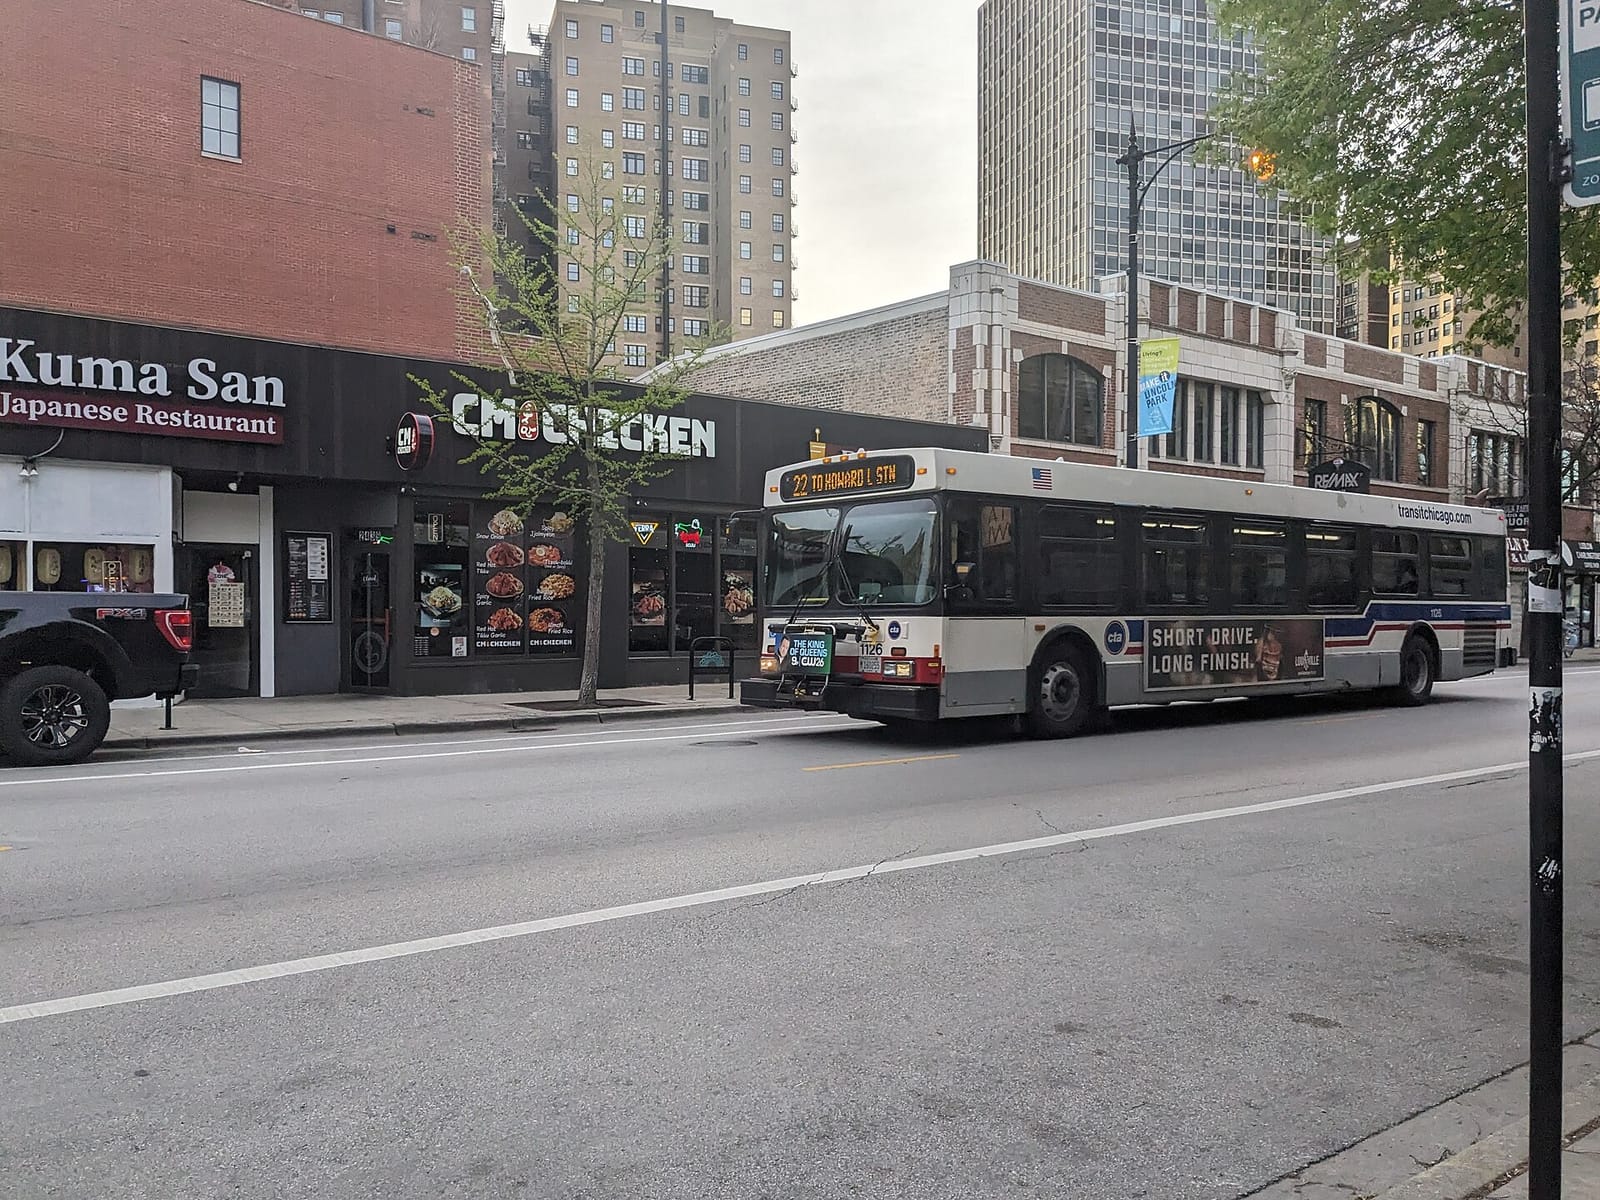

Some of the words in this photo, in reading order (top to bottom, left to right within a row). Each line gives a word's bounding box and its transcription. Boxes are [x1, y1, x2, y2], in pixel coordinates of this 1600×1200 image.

[0, 337, 172, 396] Kuma
[187, 358, 286, 407] San
[1160, 372, 1169, 382] it
[1146, 393, 1168, 408] PARK
[0, 392, 128, 421] Japanese
[135, 403, 277, 435] Restaurant
[452, 393, 516, 439] CM
[793, 473, 808, 496] 22
[812, 473, 823, 492] TO
[825, 469, 864, 490] HOWARD
[867, 467, 873, 486] L
[876, 464, 896, 484] STN
[1315, 472, 1359, 488] RE/MAX
[1398, 503, 1472, 524] transitchicago.com
[96, 608, 147, 620] FX4
[793, 640, 806, 648] THE
[807, 640, 825, 649] KING
[1108, 631, 1122, 643] cta
[1152, 628, 1204, 647] SHORT
[1211, 627, 1258, 646] DRIVE.
[789, 648, 799, 656] OF
[800, 648, 828, 657] QUEENS
[860, 643, 883, 655] 1126
[1152, 654, 1194, 674] LONG
[1200, 652, 1255, 671] FINISH.
